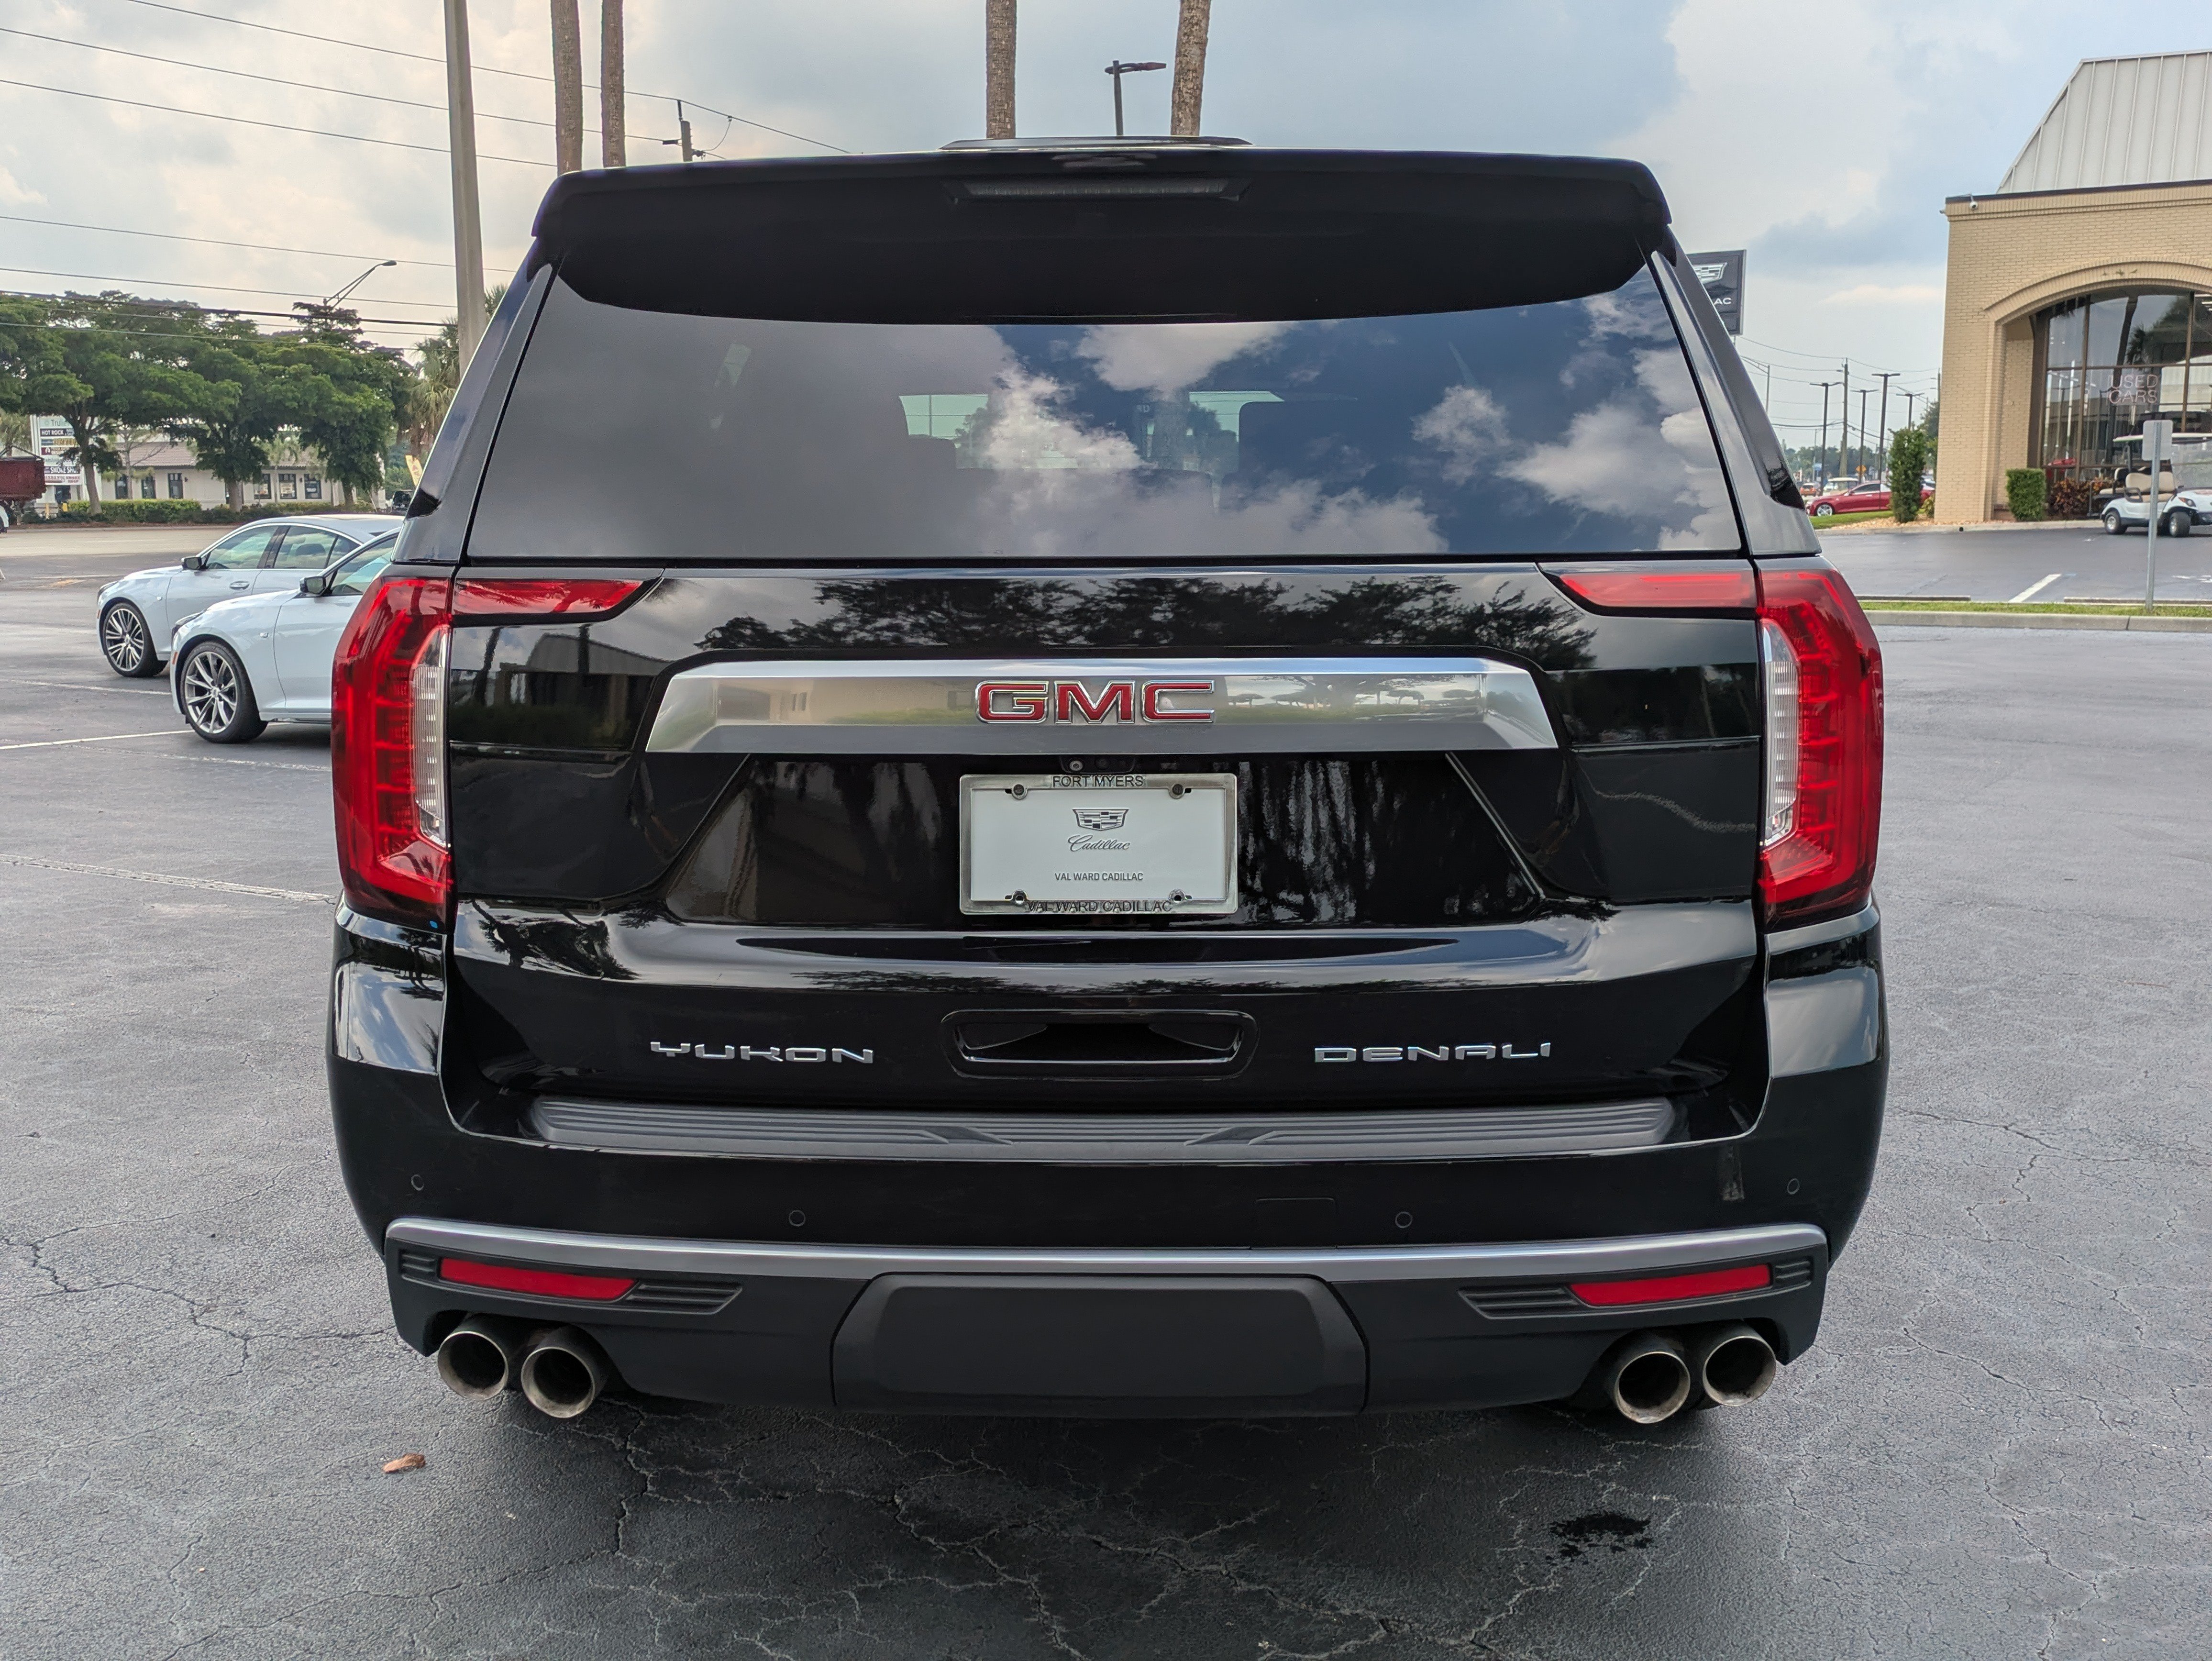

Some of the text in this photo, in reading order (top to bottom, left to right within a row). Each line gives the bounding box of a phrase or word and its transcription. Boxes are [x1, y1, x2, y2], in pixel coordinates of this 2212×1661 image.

[2110, 374, 2158, 389] USED
[2109, 389, 2157, 404] CARS
[975, 680, 1215, 724] GMC
[1052, 775, 1144, 787] FORT MYERS
[1067, 834, 1130, 852] Cadillac
[1054, 872, 1143, 881] VAL WARD CADILLAC
[1029, 901, 1172, 912] VAL WARD CADILLAC
[650, 1041, 873, 1064] YUKON
[1315, 1042, 1551, 1063] DENALI
